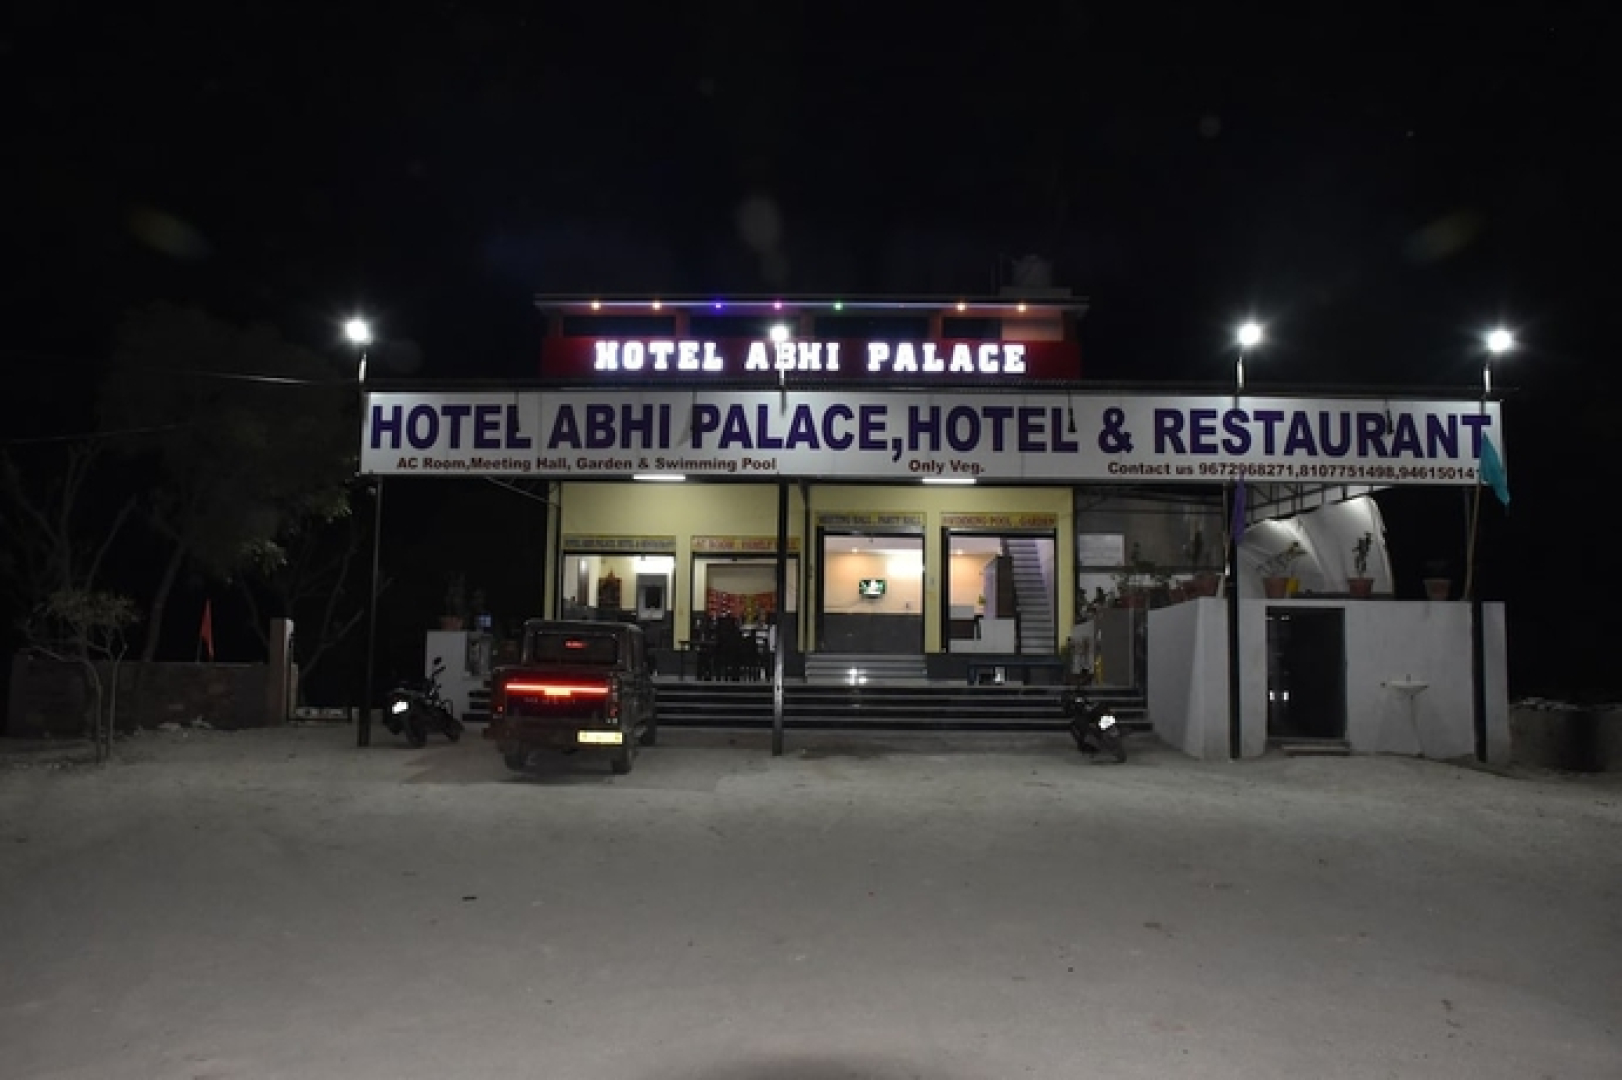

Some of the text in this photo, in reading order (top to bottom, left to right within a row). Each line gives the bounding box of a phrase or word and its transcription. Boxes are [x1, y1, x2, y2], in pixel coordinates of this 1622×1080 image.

[594, 341, 1027, 373] HOTEL ABHI PALACE
[370, 403, 532, 450] HOTEL
[546, 403, 672, 450] ABHI
[1097, 406, 1134, 454] &
[1154, 408, 1492, 459] RESTAURANT
[397, 457, 419, 469] AC
[536, 457, 572, 471] Hall,
[576, 457, 632, 470] Garden
[637, 457, 649, 470] &
[654, 457, 737, 472] Swimming
[742, 457, 777, 470] Pool
[908, 459, 986, 474] Only Veg.
[1107, 461, 1171, 475] Contact
[1175, 465, 1195, 475] us
